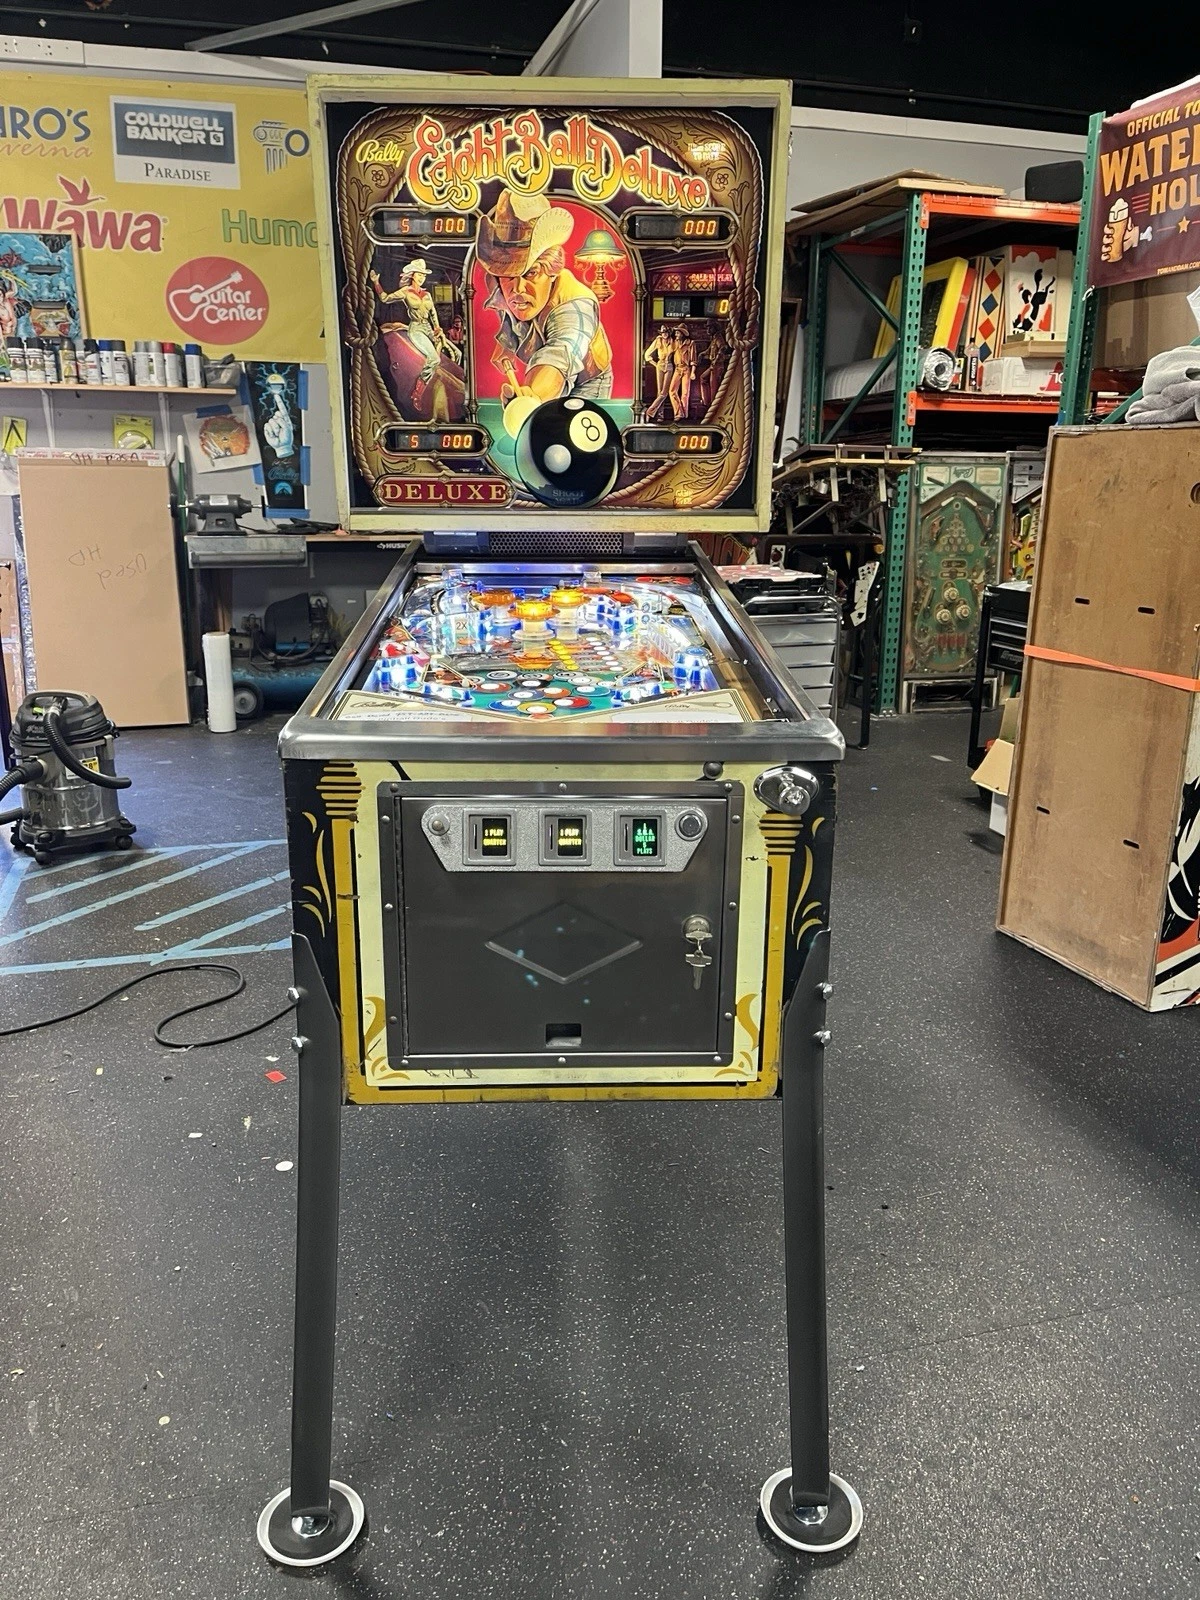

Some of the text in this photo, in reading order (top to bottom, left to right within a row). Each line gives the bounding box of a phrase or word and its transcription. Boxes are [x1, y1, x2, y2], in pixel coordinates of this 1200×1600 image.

[0, 106, 91, 142] RO'S
[1127, 106, 1181, 138] OFFICIAL
[356, 139, 405, 168] Bally
[407, 110, 709, 213] Eight Ball Deluxe
[3, 197, 162, 252] Wawa
[434, 218, 466, 233] 000
[684, 220, 717, 235] 000
[203, 304, 263, 325] Center
[719, 299, 729, 314] 0
[581, 416, 601, 442] 8
[442, 434, 473, 448] 000
[679, 435, 709, 449] 000
[384, 483, 507, 500] DELUXE
